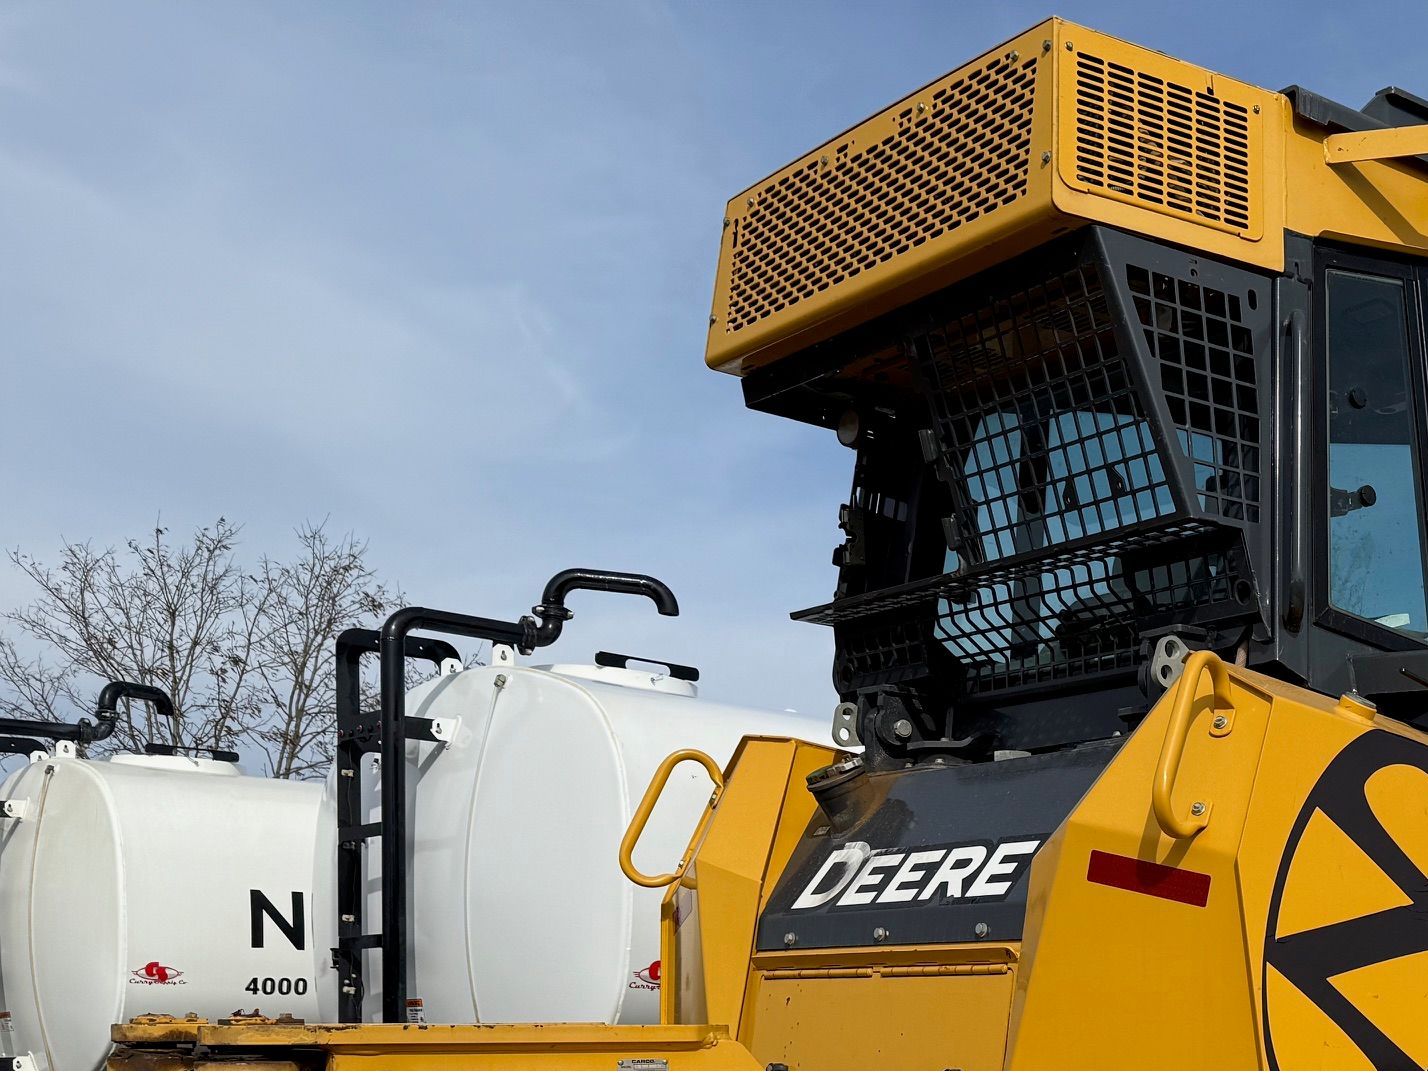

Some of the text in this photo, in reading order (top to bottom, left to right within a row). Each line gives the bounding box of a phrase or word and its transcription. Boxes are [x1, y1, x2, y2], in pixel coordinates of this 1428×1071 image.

[791, 840, 1040, 910] DEERE
[249, 888, 306, 951] N
[244, 977, 308, 996] 4000
